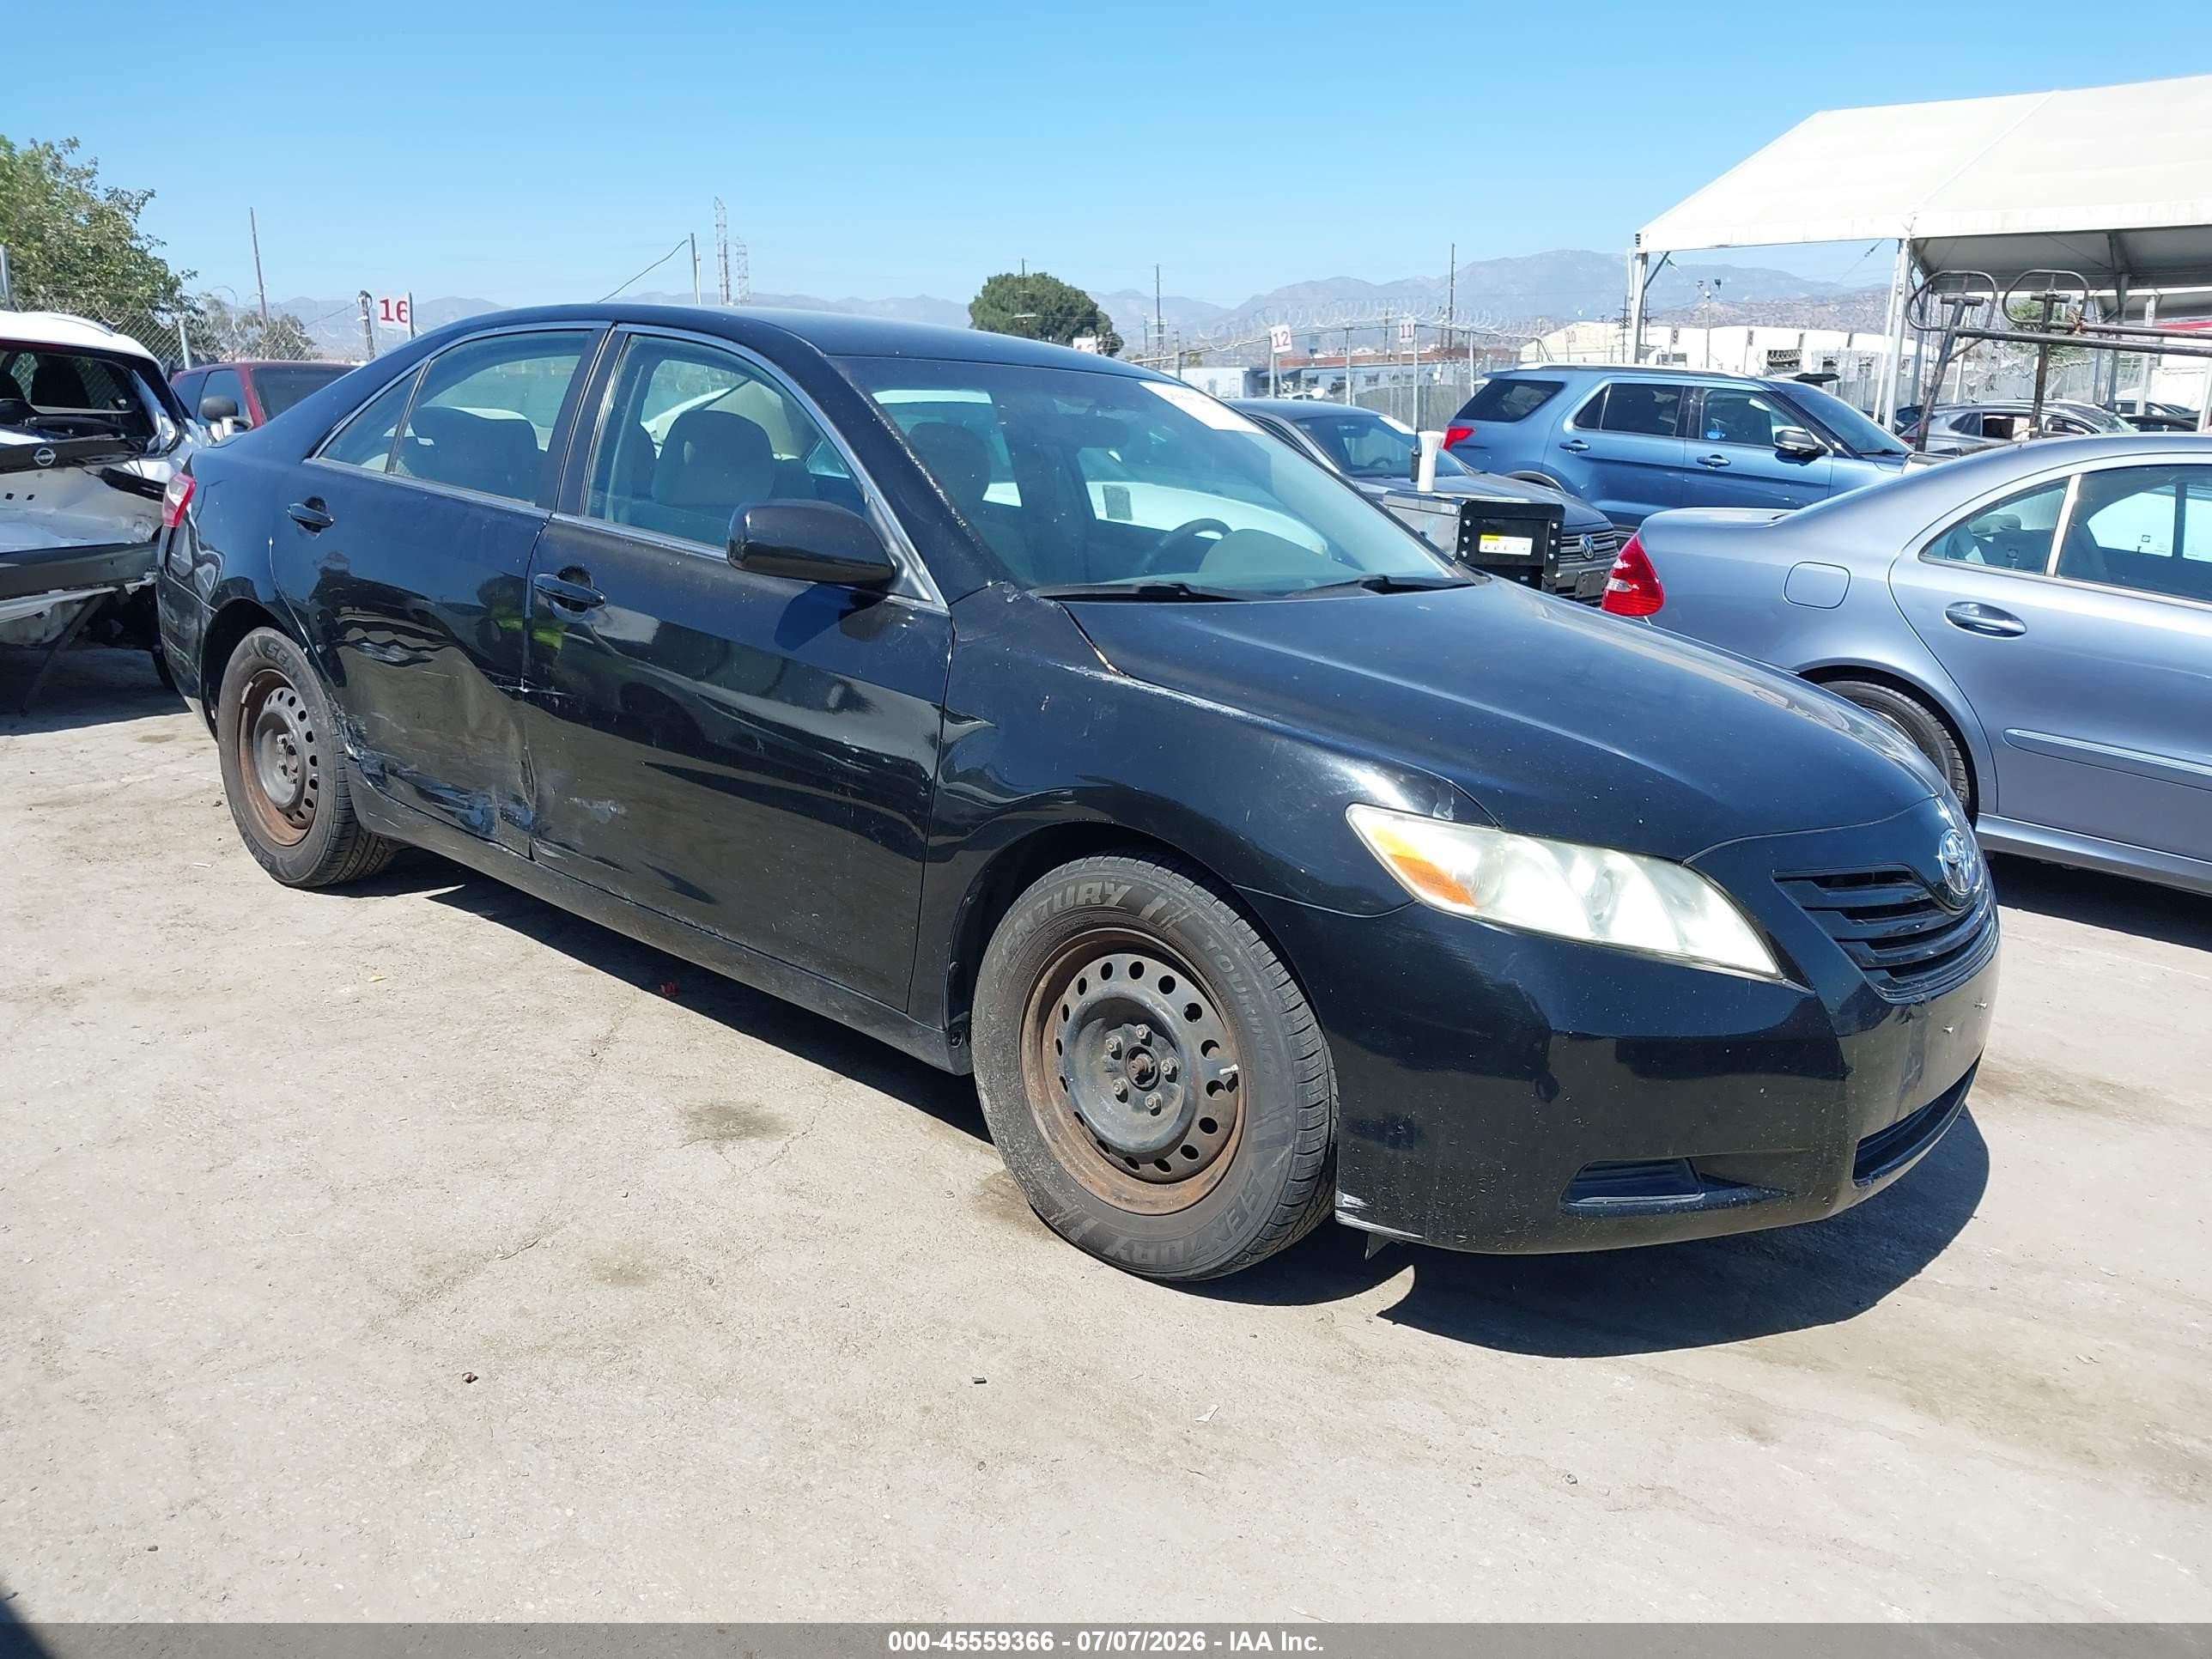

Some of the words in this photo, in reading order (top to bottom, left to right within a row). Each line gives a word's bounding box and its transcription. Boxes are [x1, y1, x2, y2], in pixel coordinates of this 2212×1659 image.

[380, 299, 408, 324] 16
[1401, 324, 1413, 338] 11
[1565, 330, 1577, 344] 10
[1672, 329, 1679, 343] 9
[1273, 331, 1291, 348] 12
